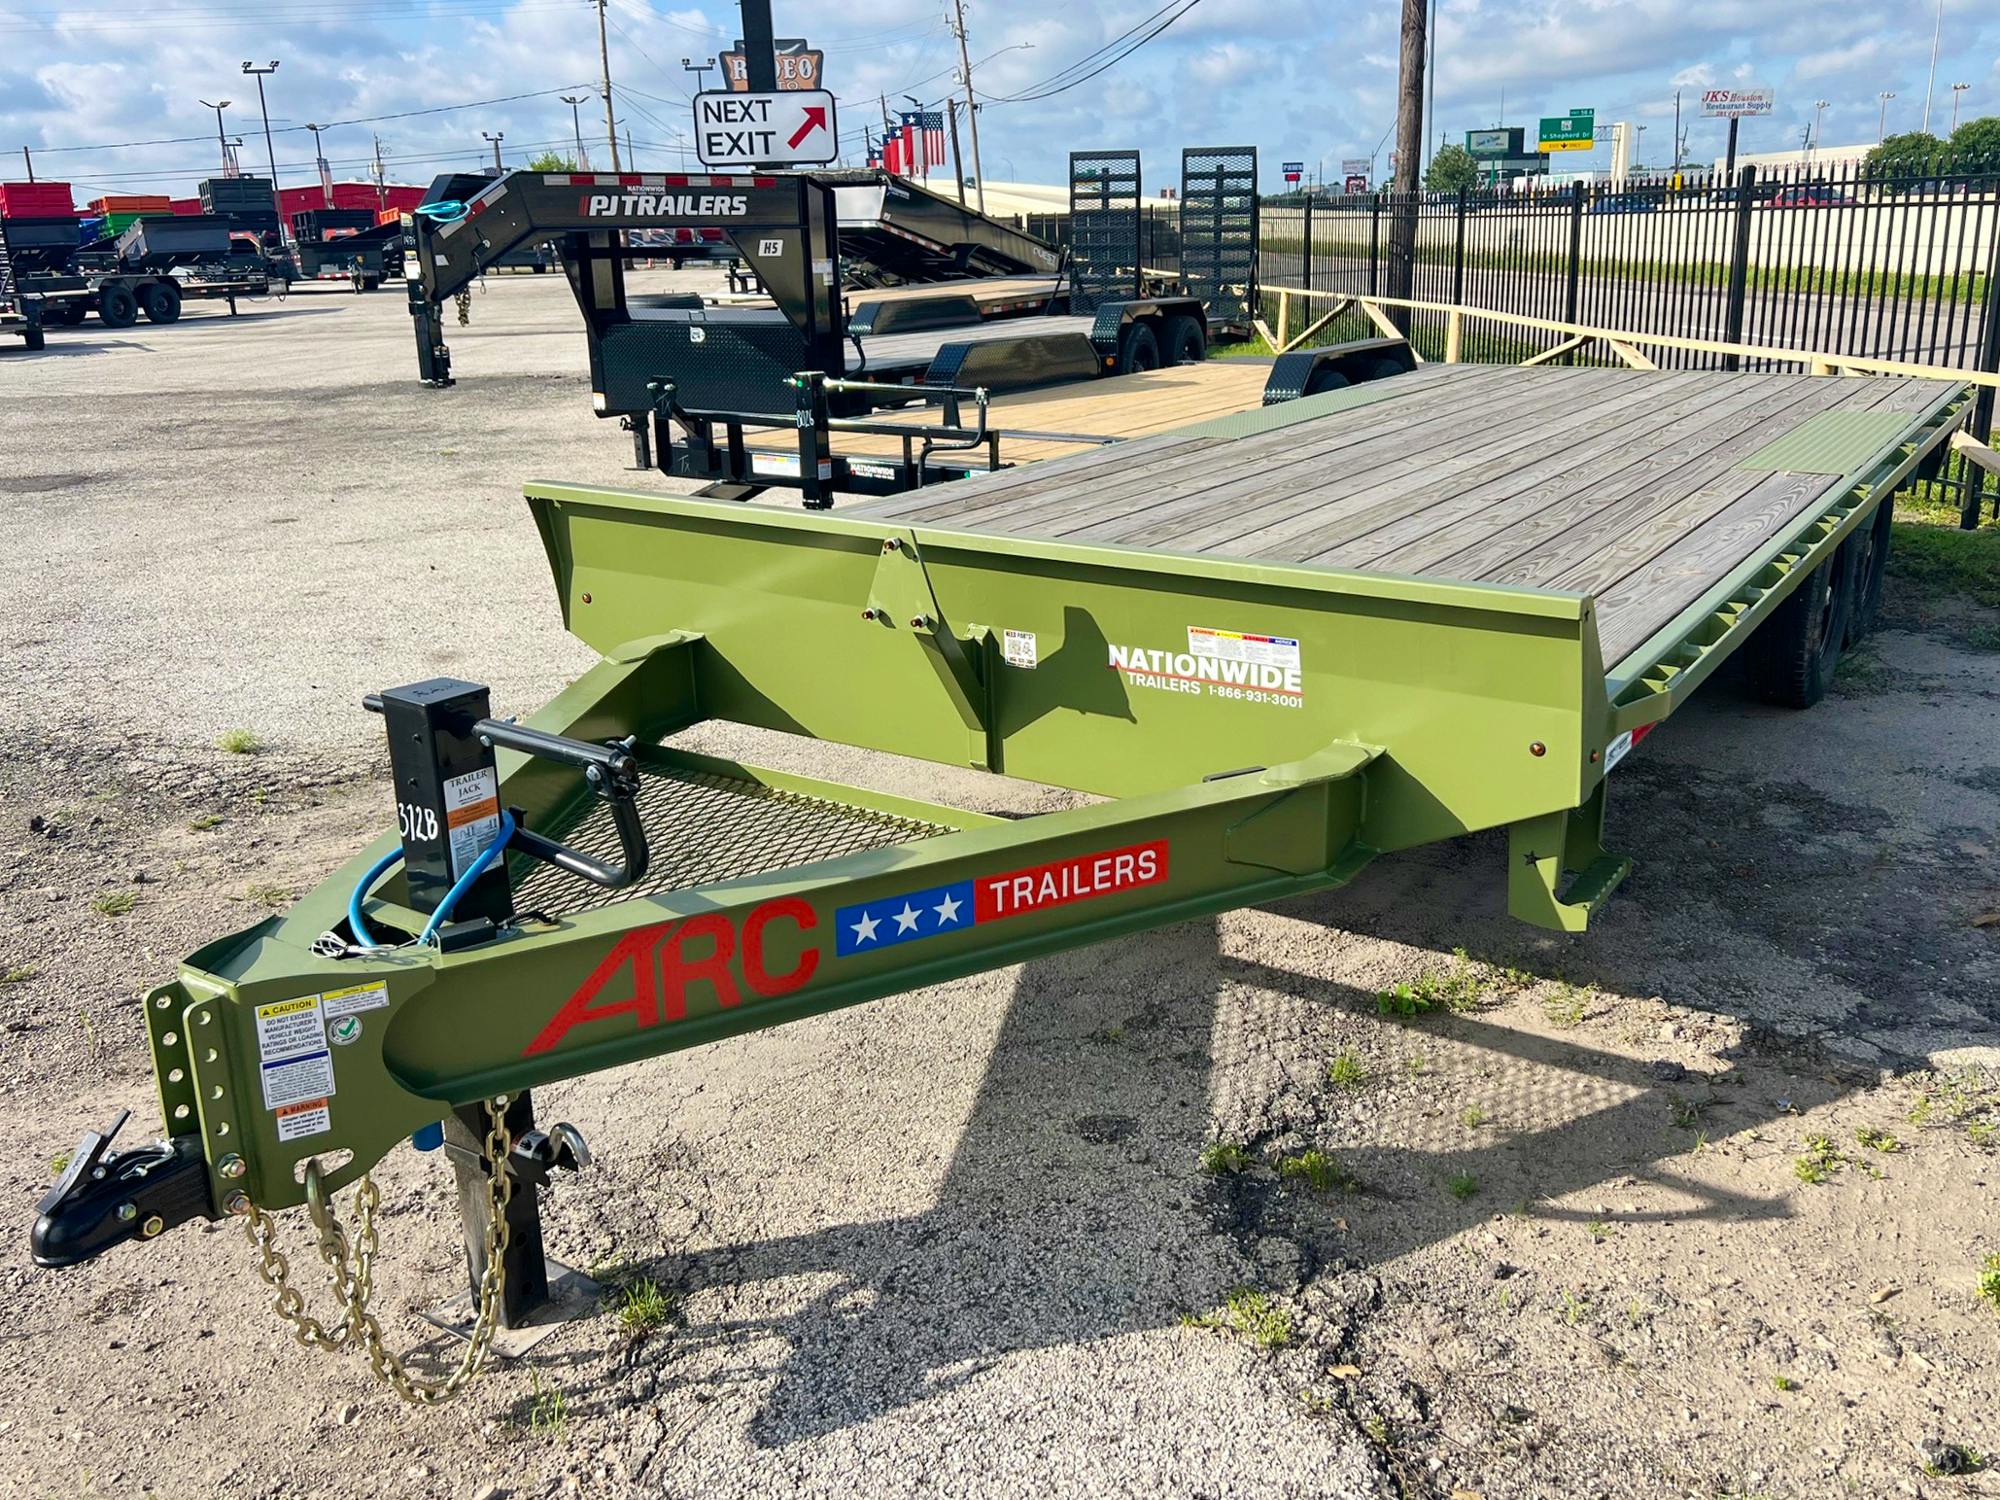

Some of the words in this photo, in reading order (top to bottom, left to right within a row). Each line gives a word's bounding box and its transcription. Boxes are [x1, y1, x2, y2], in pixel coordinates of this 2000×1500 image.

[1702, 90, 1730, 102] JKS
[1730, 93, 1763, 102] Houston
[703, 99, 772, 124] NEXT
[1705, 102, 1746, 111] Restaurant
[1747, 101, 1772, 111] Supply
[706, 130, 777, 157] EXIT
[627, 185, 666, 193] NATIONWIDE
[589, 195, 619, 217] PJ
[621, 195, 748, 216] TRAILERS
[763, 242, 779, 255] H5
[850, 463, 895, 477] NATIONWIDE
[1108, 643, 1302, 692] NATIONWIDE
[1126, 671, 1201, 694] TRAILERS
[1208, 686, 1303, 709] 1-866-931-3001
[450, 770, 488, 788] TRAILER
[459, 782, 481, 799] JACK
[990, 848, 1158, 913] TRAILERS
[520, 899, 820, 1057] ARC
[272, 1000, 312, 1014] CAUTION
[276, 1016, 289, 1024] NOT
[290, 1011, 314, 1021] EXCEED
[264, 1018, 318, 1034] MANUFACTURER'S
[267, 1030, 292, 1040] VEHICLE
[293, 1025, 316, 1035] WEIGHT
[262, 1038, 288, 1048] RATINGS
[288, 1035, 297, 1043] OR
[297, 1030, 324, 1041] LOADING
[290, 1100, 322, 1112] WARNING
